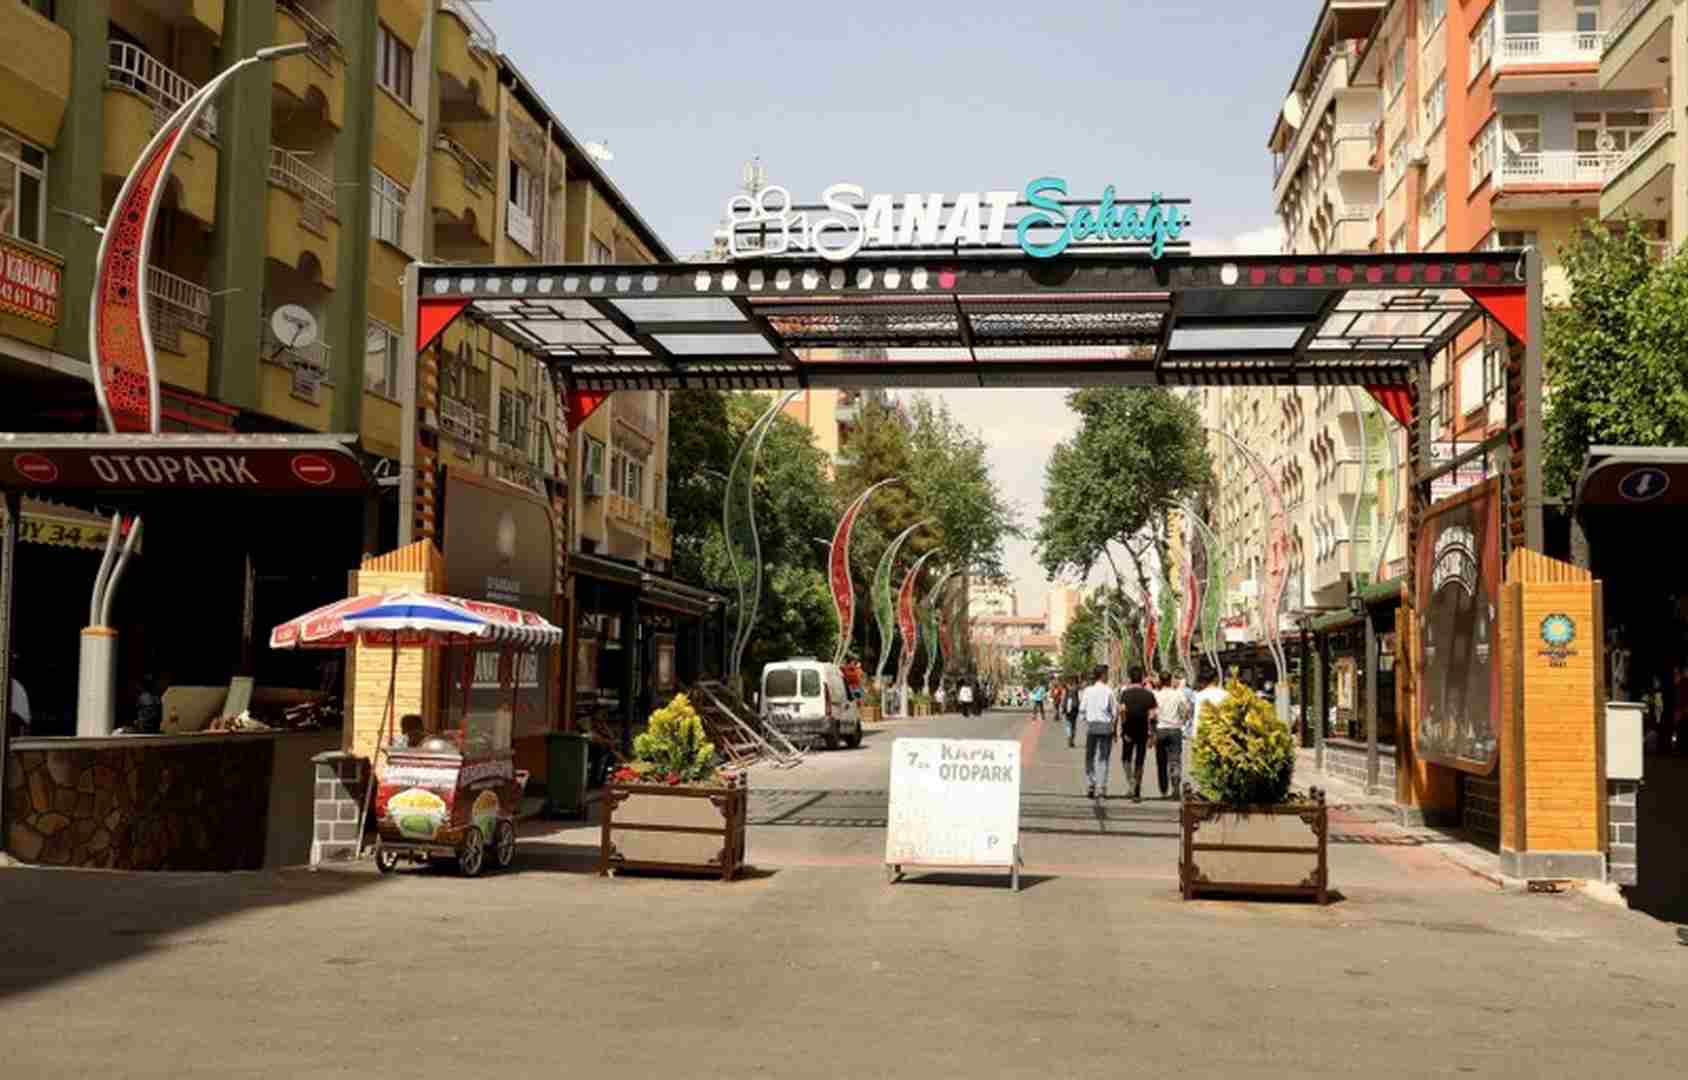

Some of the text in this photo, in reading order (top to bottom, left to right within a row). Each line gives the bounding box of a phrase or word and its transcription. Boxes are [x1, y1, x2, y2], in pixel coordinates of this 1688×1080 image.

[814, 176, 1185, 262] SANAT Sokağı
[89, 455, 260, 483] OTOPARK
[939, 763, 1013, 782] OTOPARK
